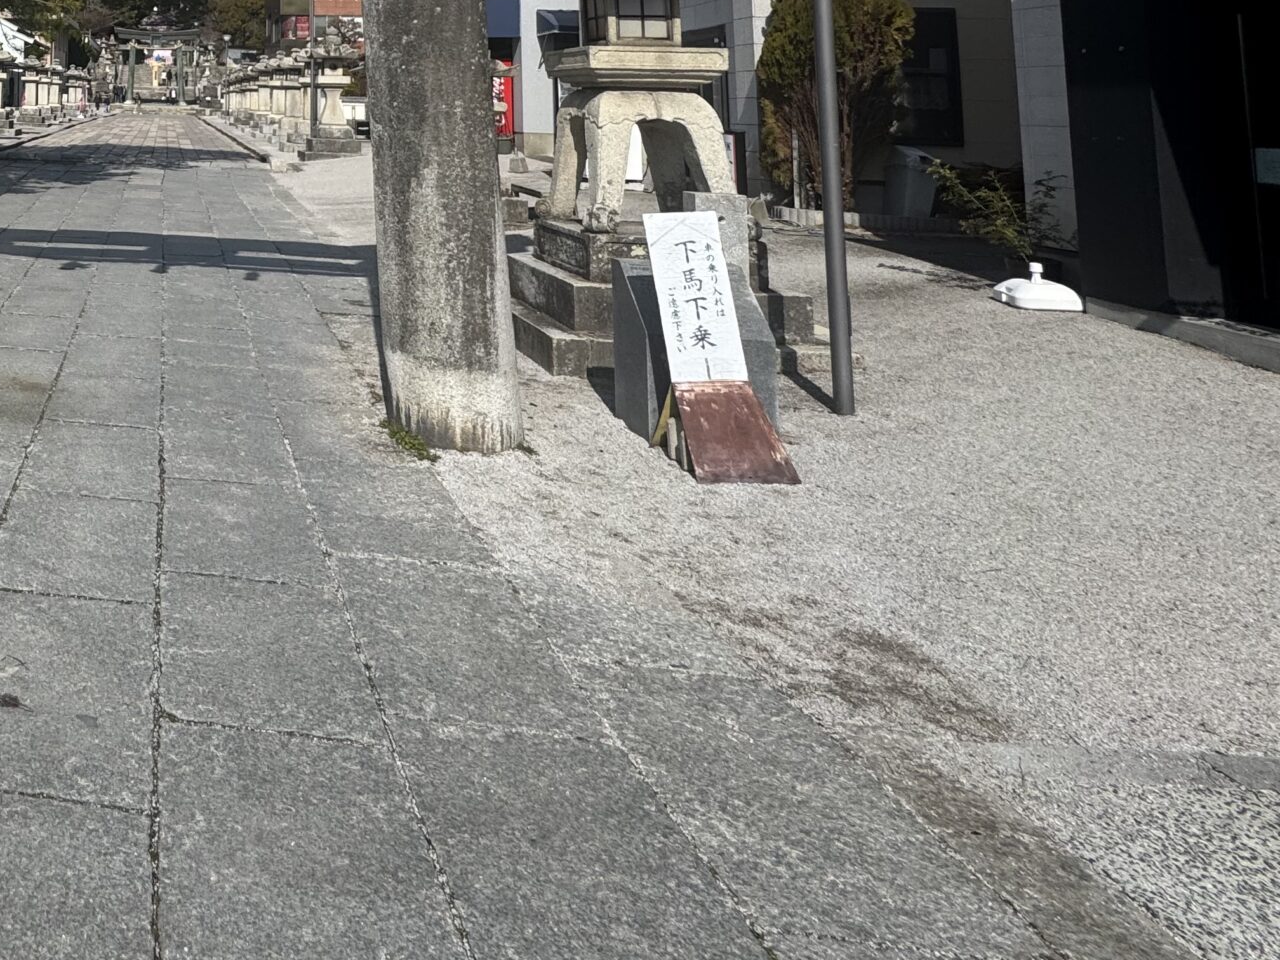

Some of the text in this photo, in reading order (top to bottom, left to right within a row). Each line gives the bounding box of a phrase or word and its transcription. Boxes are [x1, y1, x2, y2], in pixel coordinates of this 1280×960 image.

[675, 240, 718, 350] 下馬下乗
[704, 242, 727, 317] 車の乗り入れは
[667, 287, 687, 353] ご遠慮下さい
